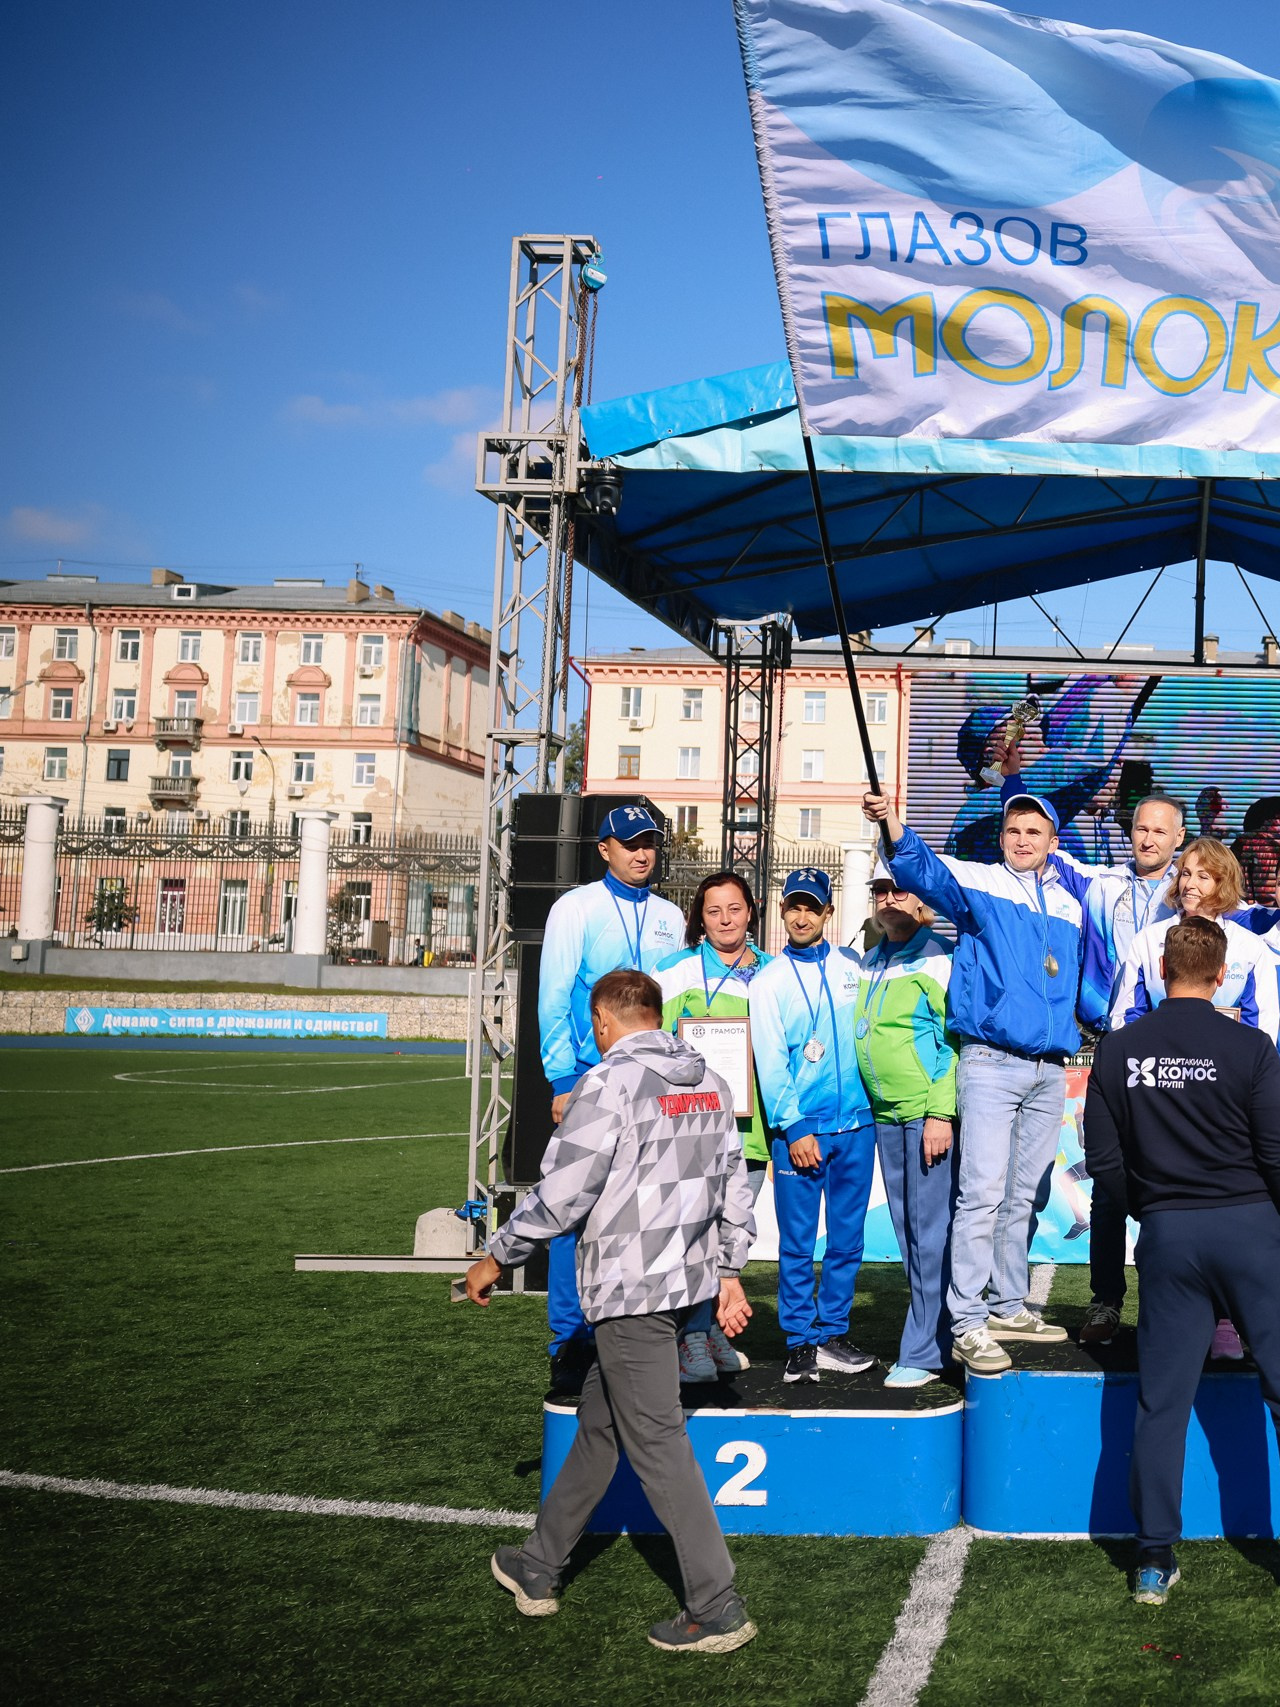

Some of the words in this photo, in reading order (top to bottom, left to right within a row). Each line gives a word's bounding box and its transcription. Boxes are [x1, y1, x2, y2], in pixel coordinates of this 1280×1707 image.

[816, 210, 1090, 267] ГЛАЗОВ
[654, 930, 674, 939] КОМОС
[102, 1013, 158, 1029] Динамо
[169, 1016, 203, 1028] сила
[206, 1016, 215, 1028] в
[217, 1016, 291, 1031] движении
[294, 1018, 302, 1030] и
[305, 1018, 379, 1033] единстве!
[710, 1027, 746, 1035] ГРАМОТА
[1159, 1057, 1214, 1068] СПАРТАКИАДА
[1157, 1066, 1217, 1081] КОМОС
[1157, 1080, 1184, 1089] ГРУПП
[656, 1091, 721, 1119] УДМУРТИЯ
[714, 1440, 768, 1507] 2
